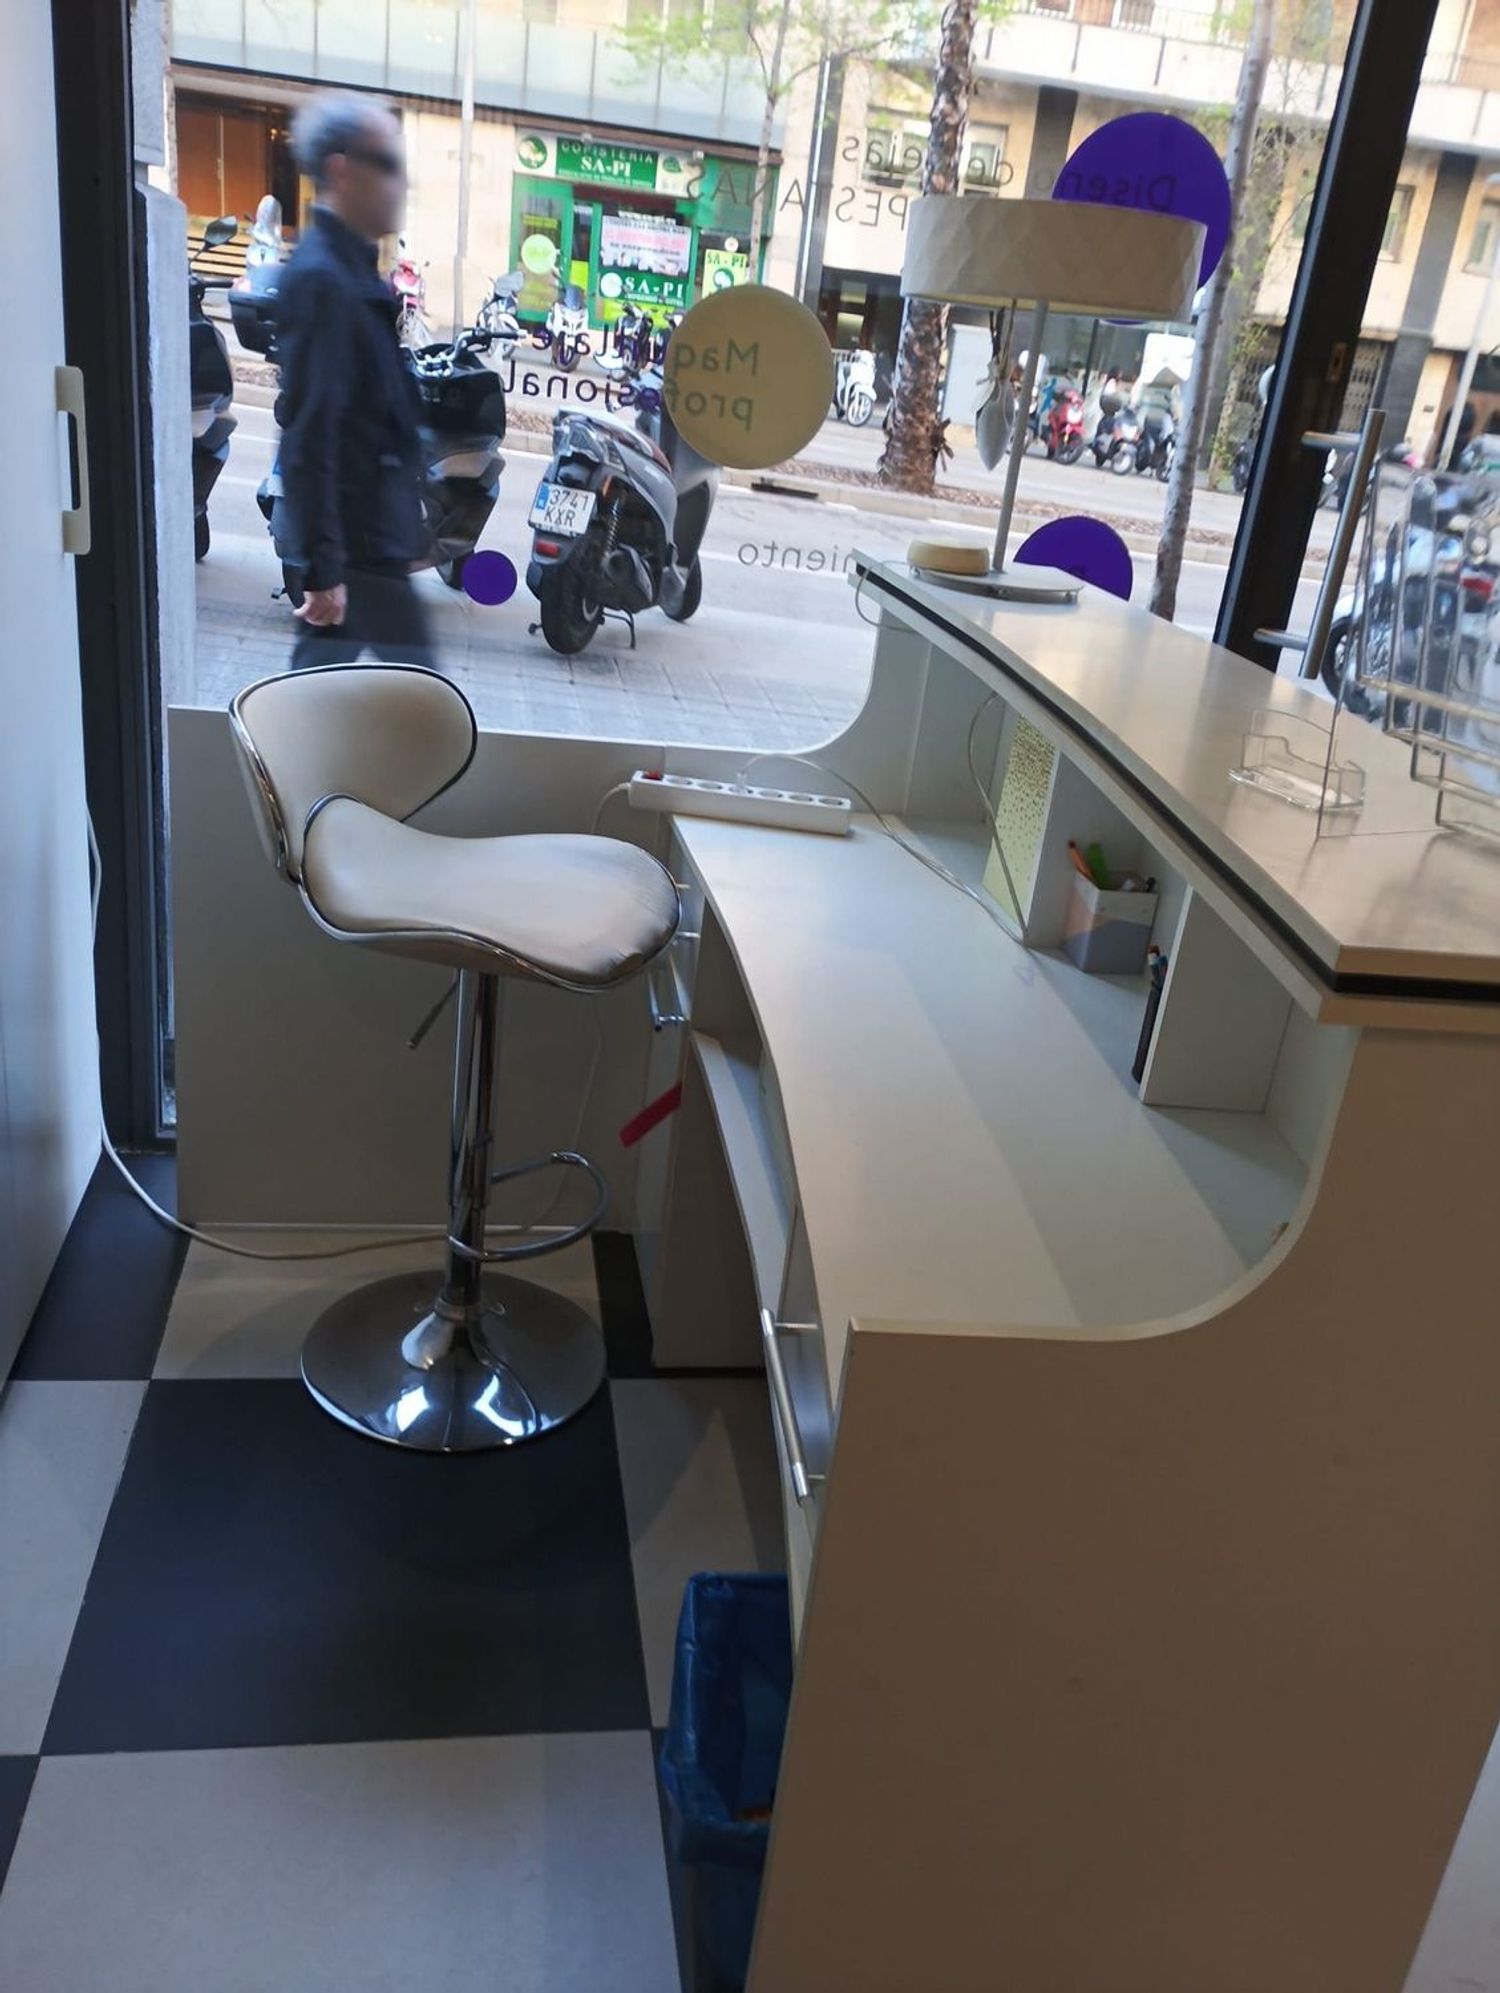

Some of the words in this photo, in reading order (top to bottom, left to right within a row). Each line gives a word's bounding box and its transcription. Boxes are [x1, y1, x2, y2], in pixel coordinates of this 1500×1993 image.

[580, 155, 631, 177] SA-PI
[549, 487, 589, 512] 3741
[543, 505, 576, 528] KXR
